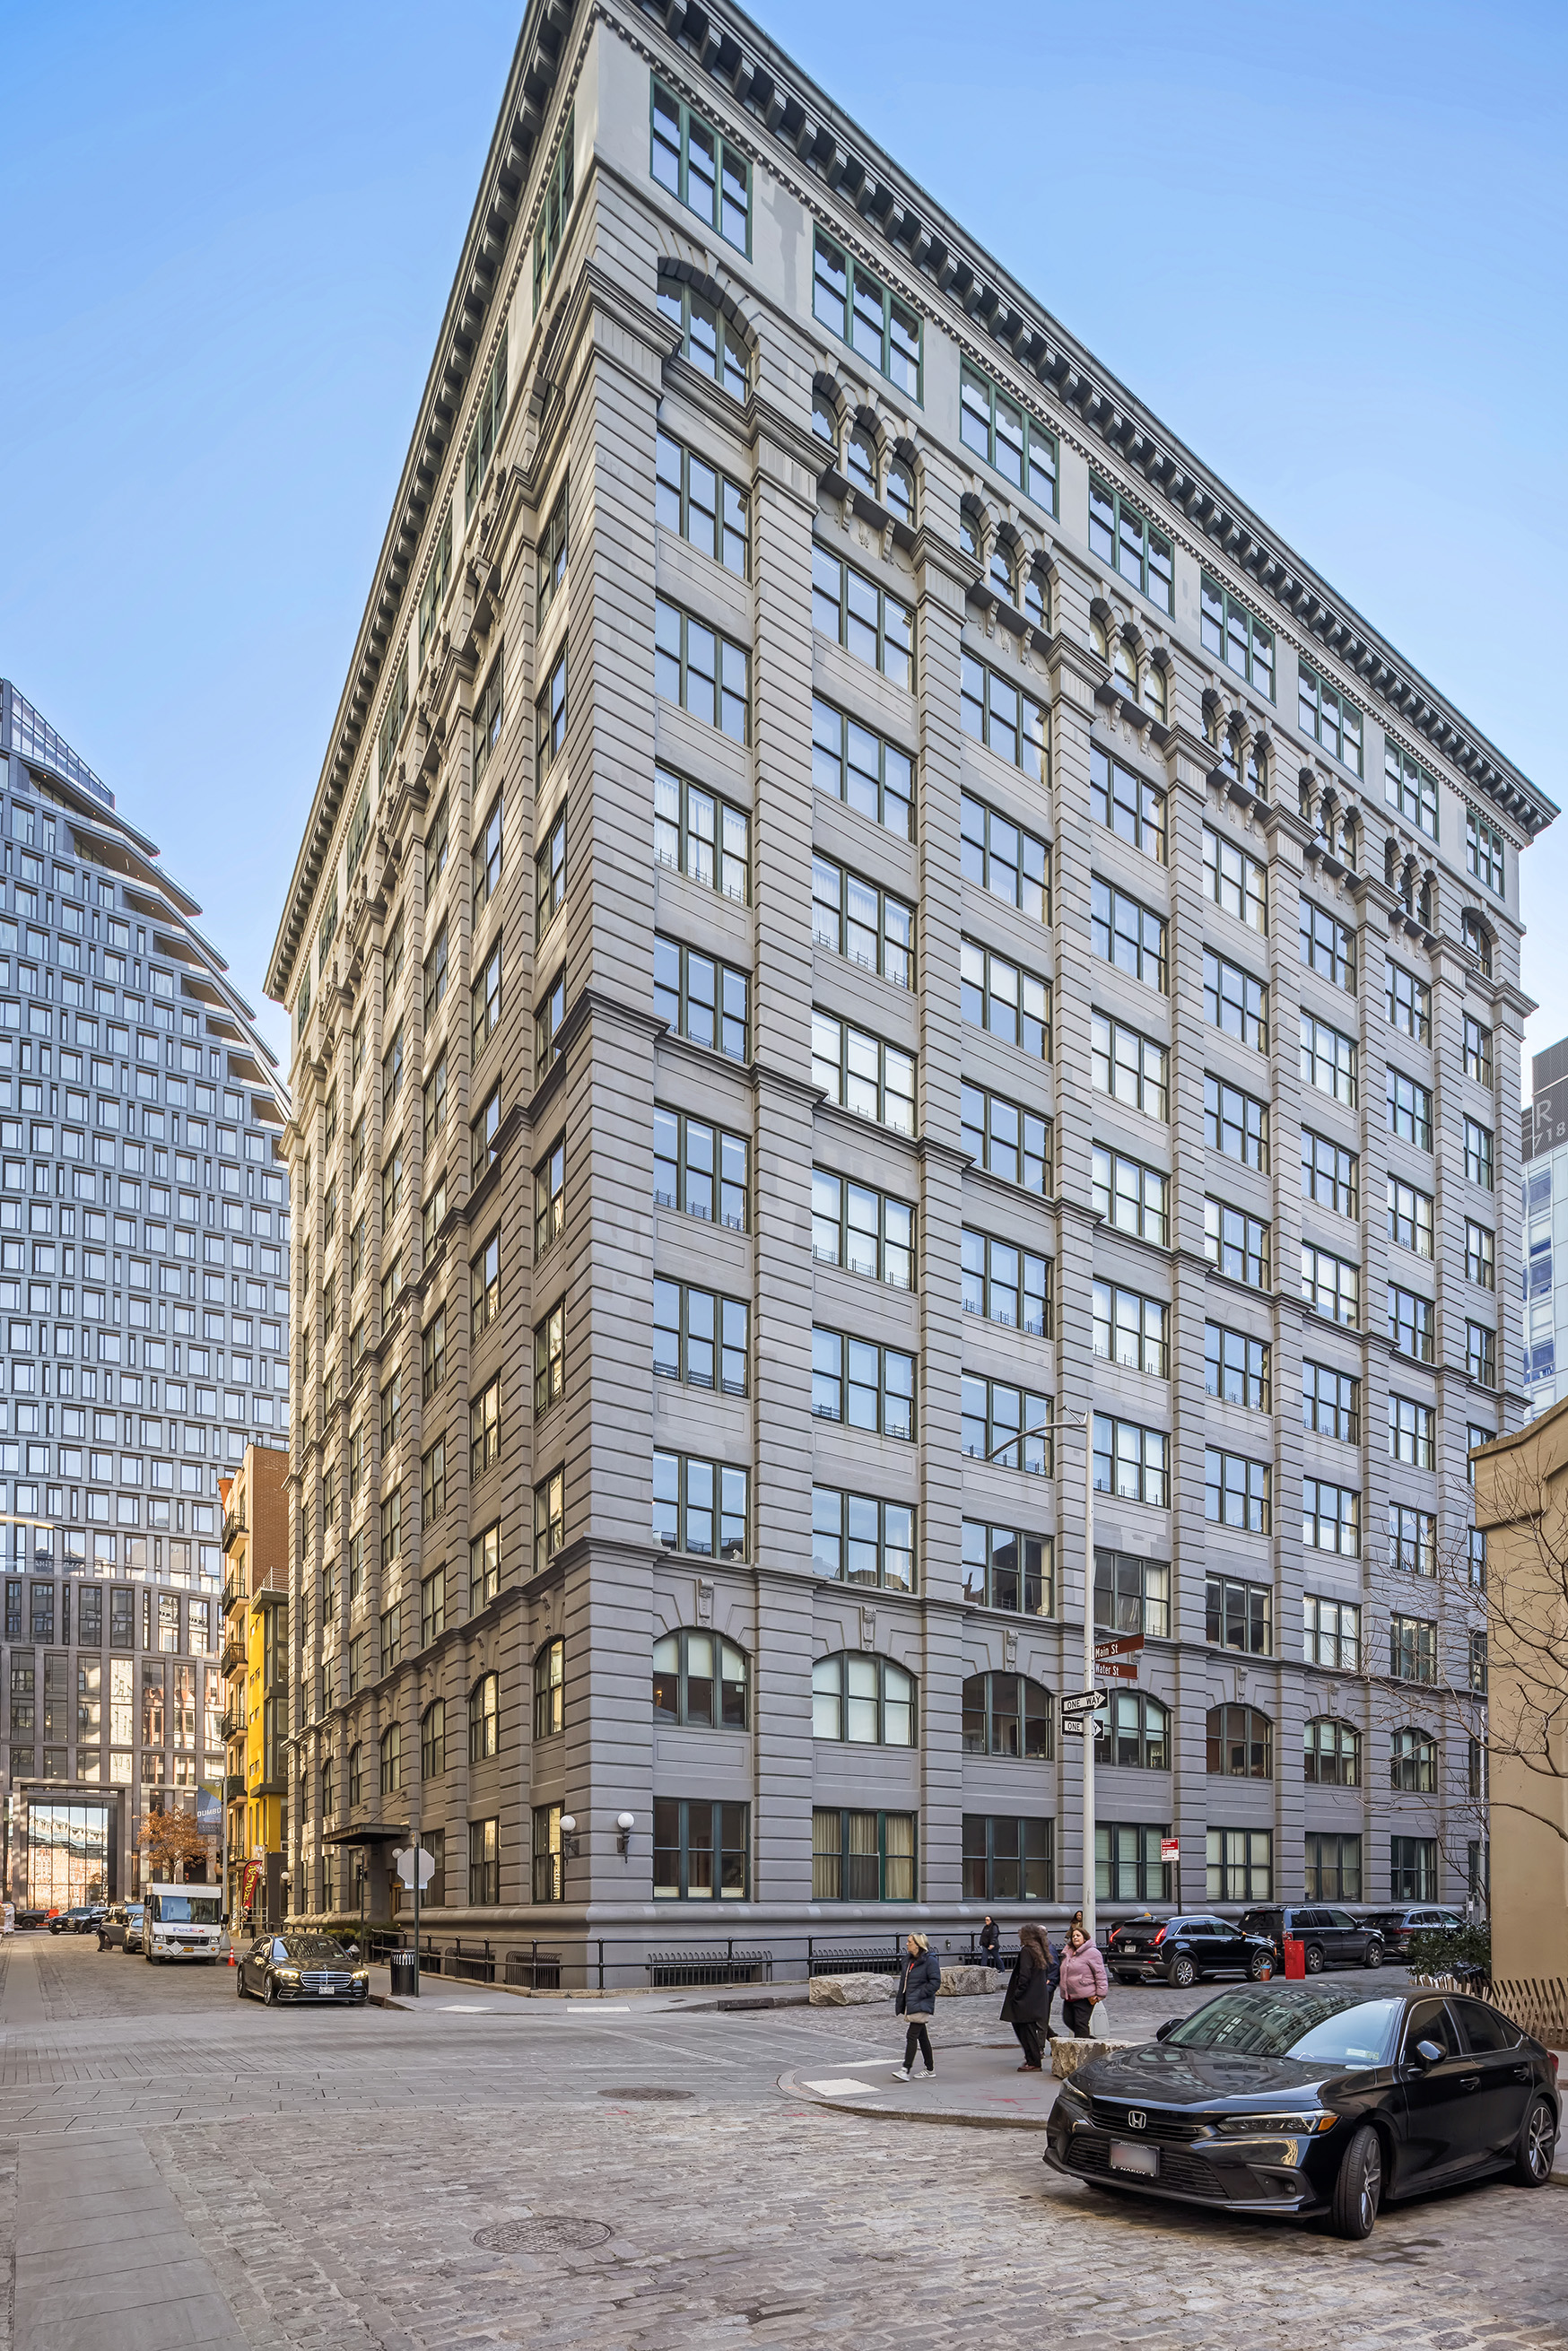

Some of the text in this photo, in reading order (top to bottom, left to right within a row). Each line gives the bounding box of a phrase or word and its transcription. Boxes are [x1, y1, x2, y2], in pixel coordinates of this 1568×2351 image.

[1095, 1643, 1119, 1659] Main St
[1095, 1663, 1119, 1676] Water St
[1067, 1695, 1102, 1710] ONE WAY
[1067, 1722, 1081, 1731] ONE
[197, 1807, 222, 1817] DUMBO
[172, 1926, 205, 1934] FedEx
